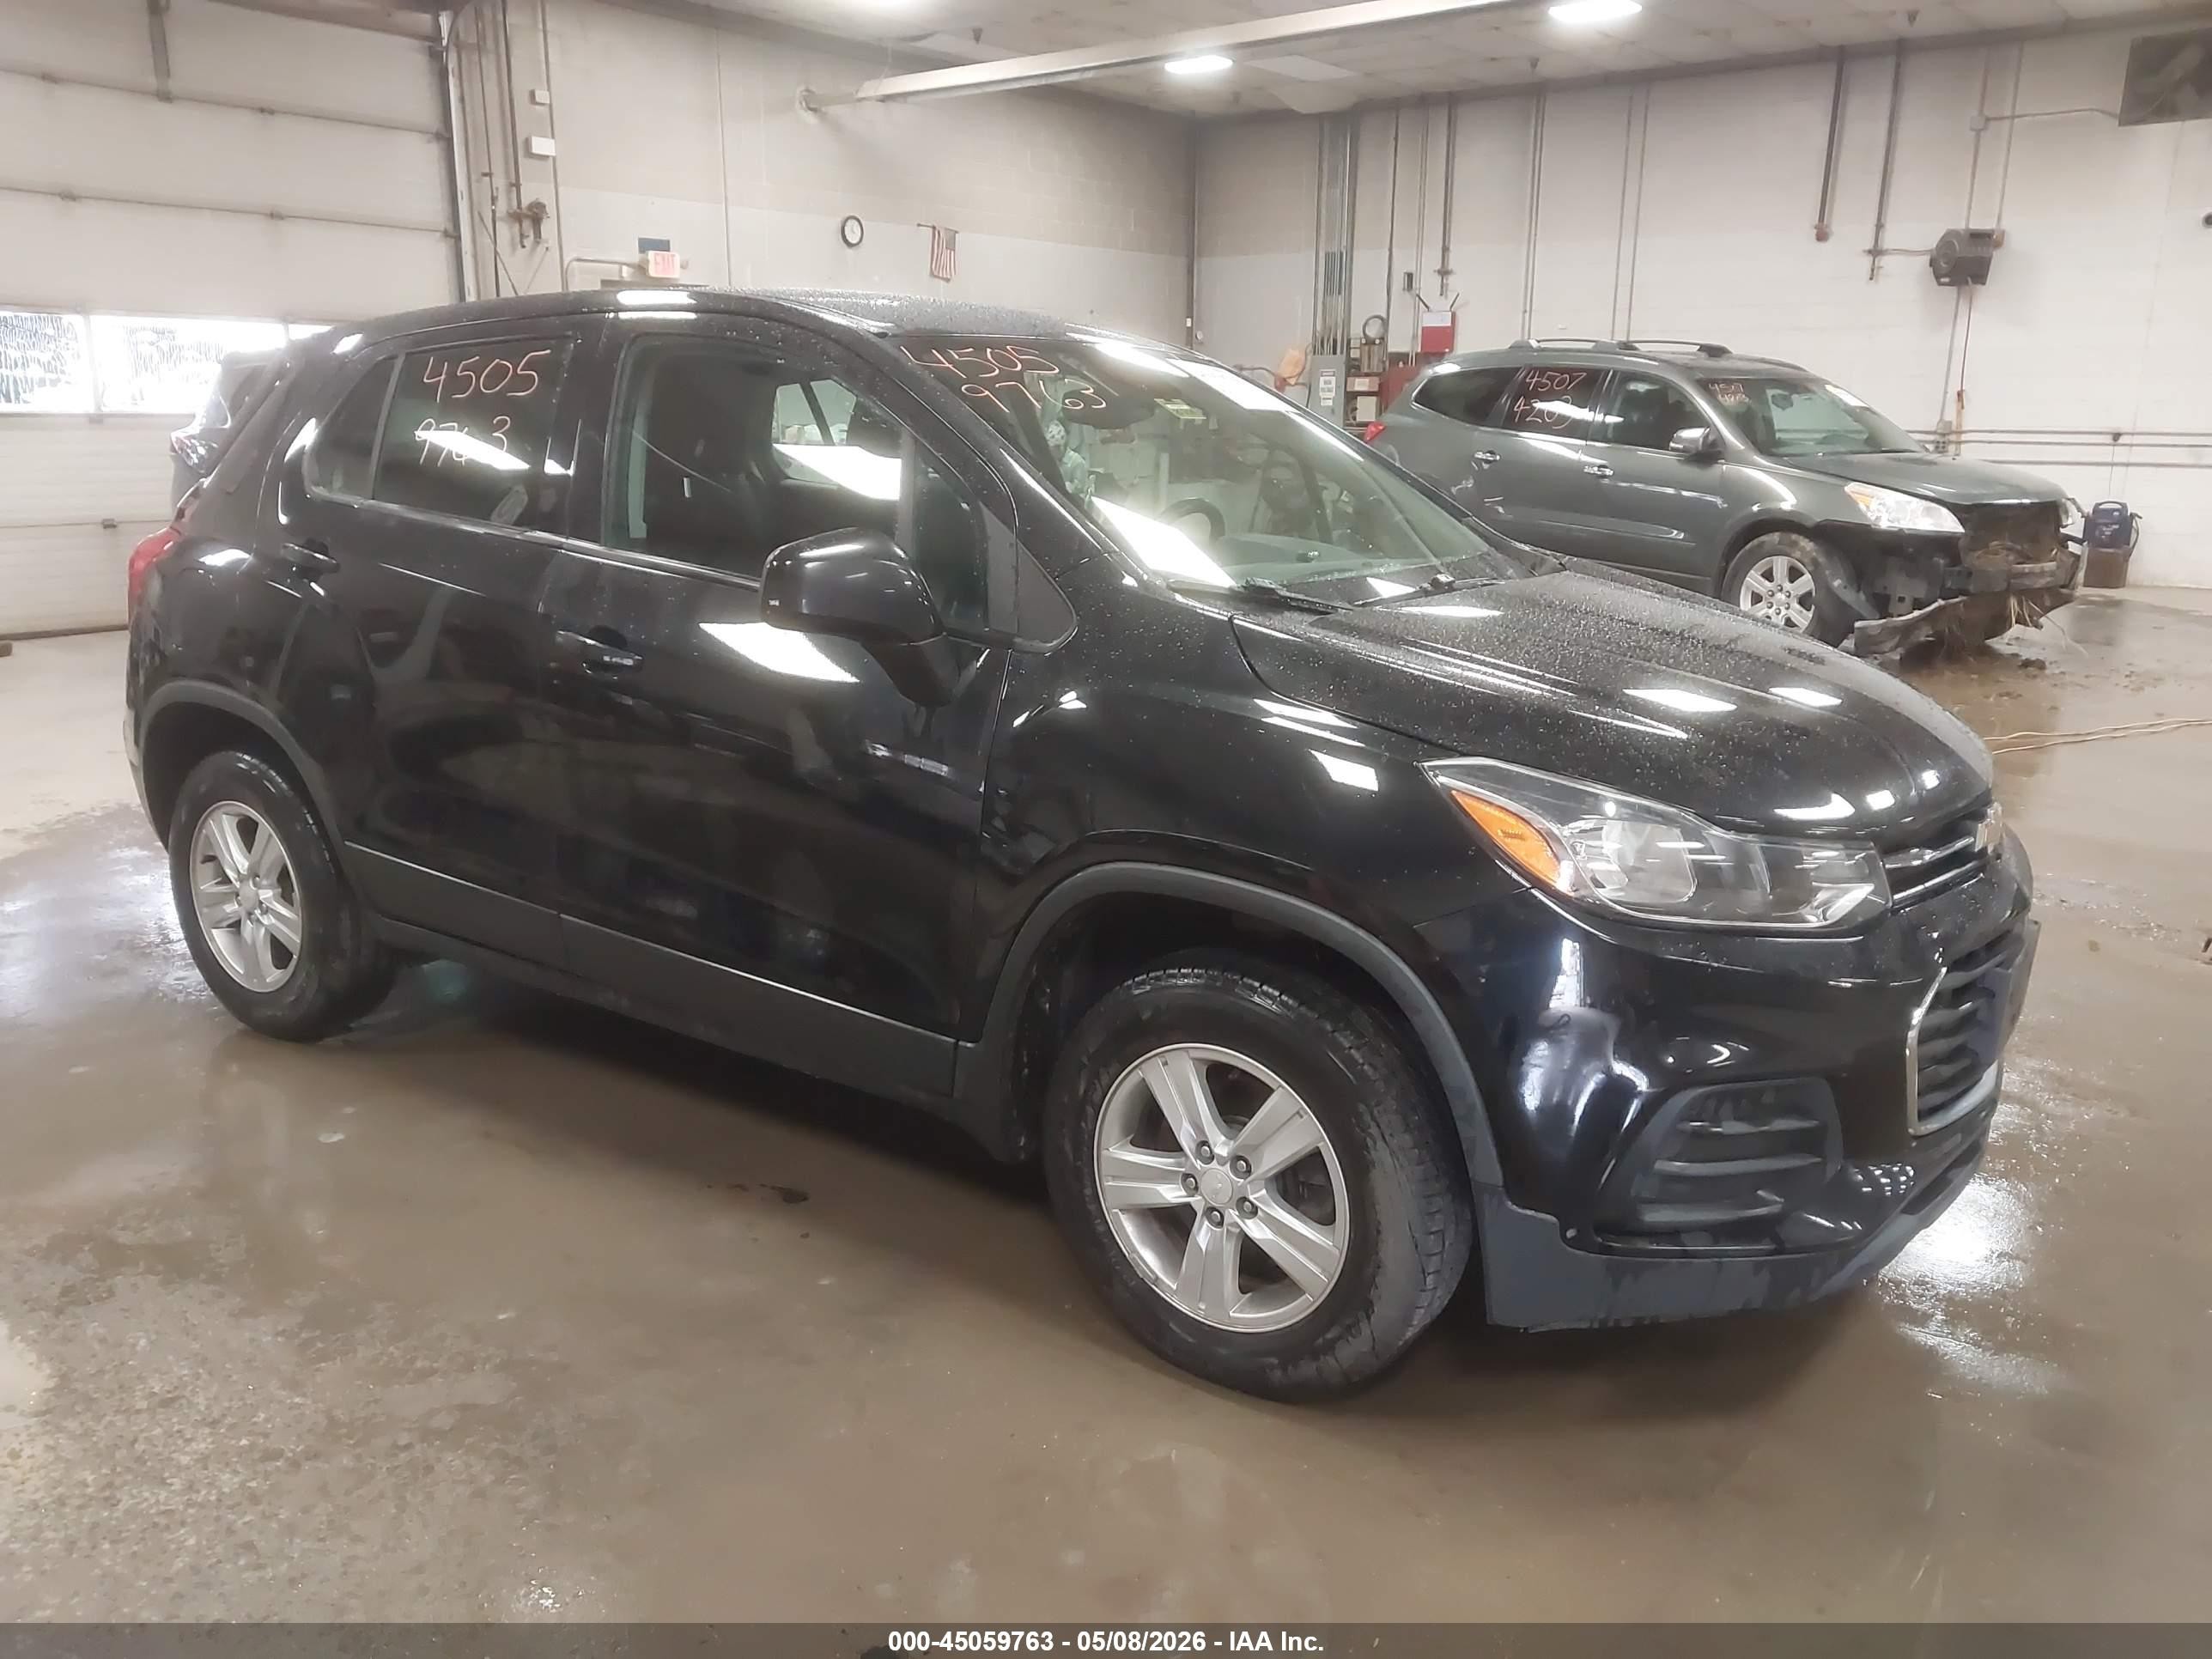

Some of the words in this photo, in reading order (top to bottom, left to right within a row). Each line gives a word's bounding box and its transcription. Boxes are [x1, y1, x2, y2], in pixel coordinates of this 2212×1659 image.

[422, 349, 551, 404] 4505
[899, 344, 1060, 379] 4505
[961, 378, 1107, 414] 9763
[1525, 369, 1588, 392] 4507
